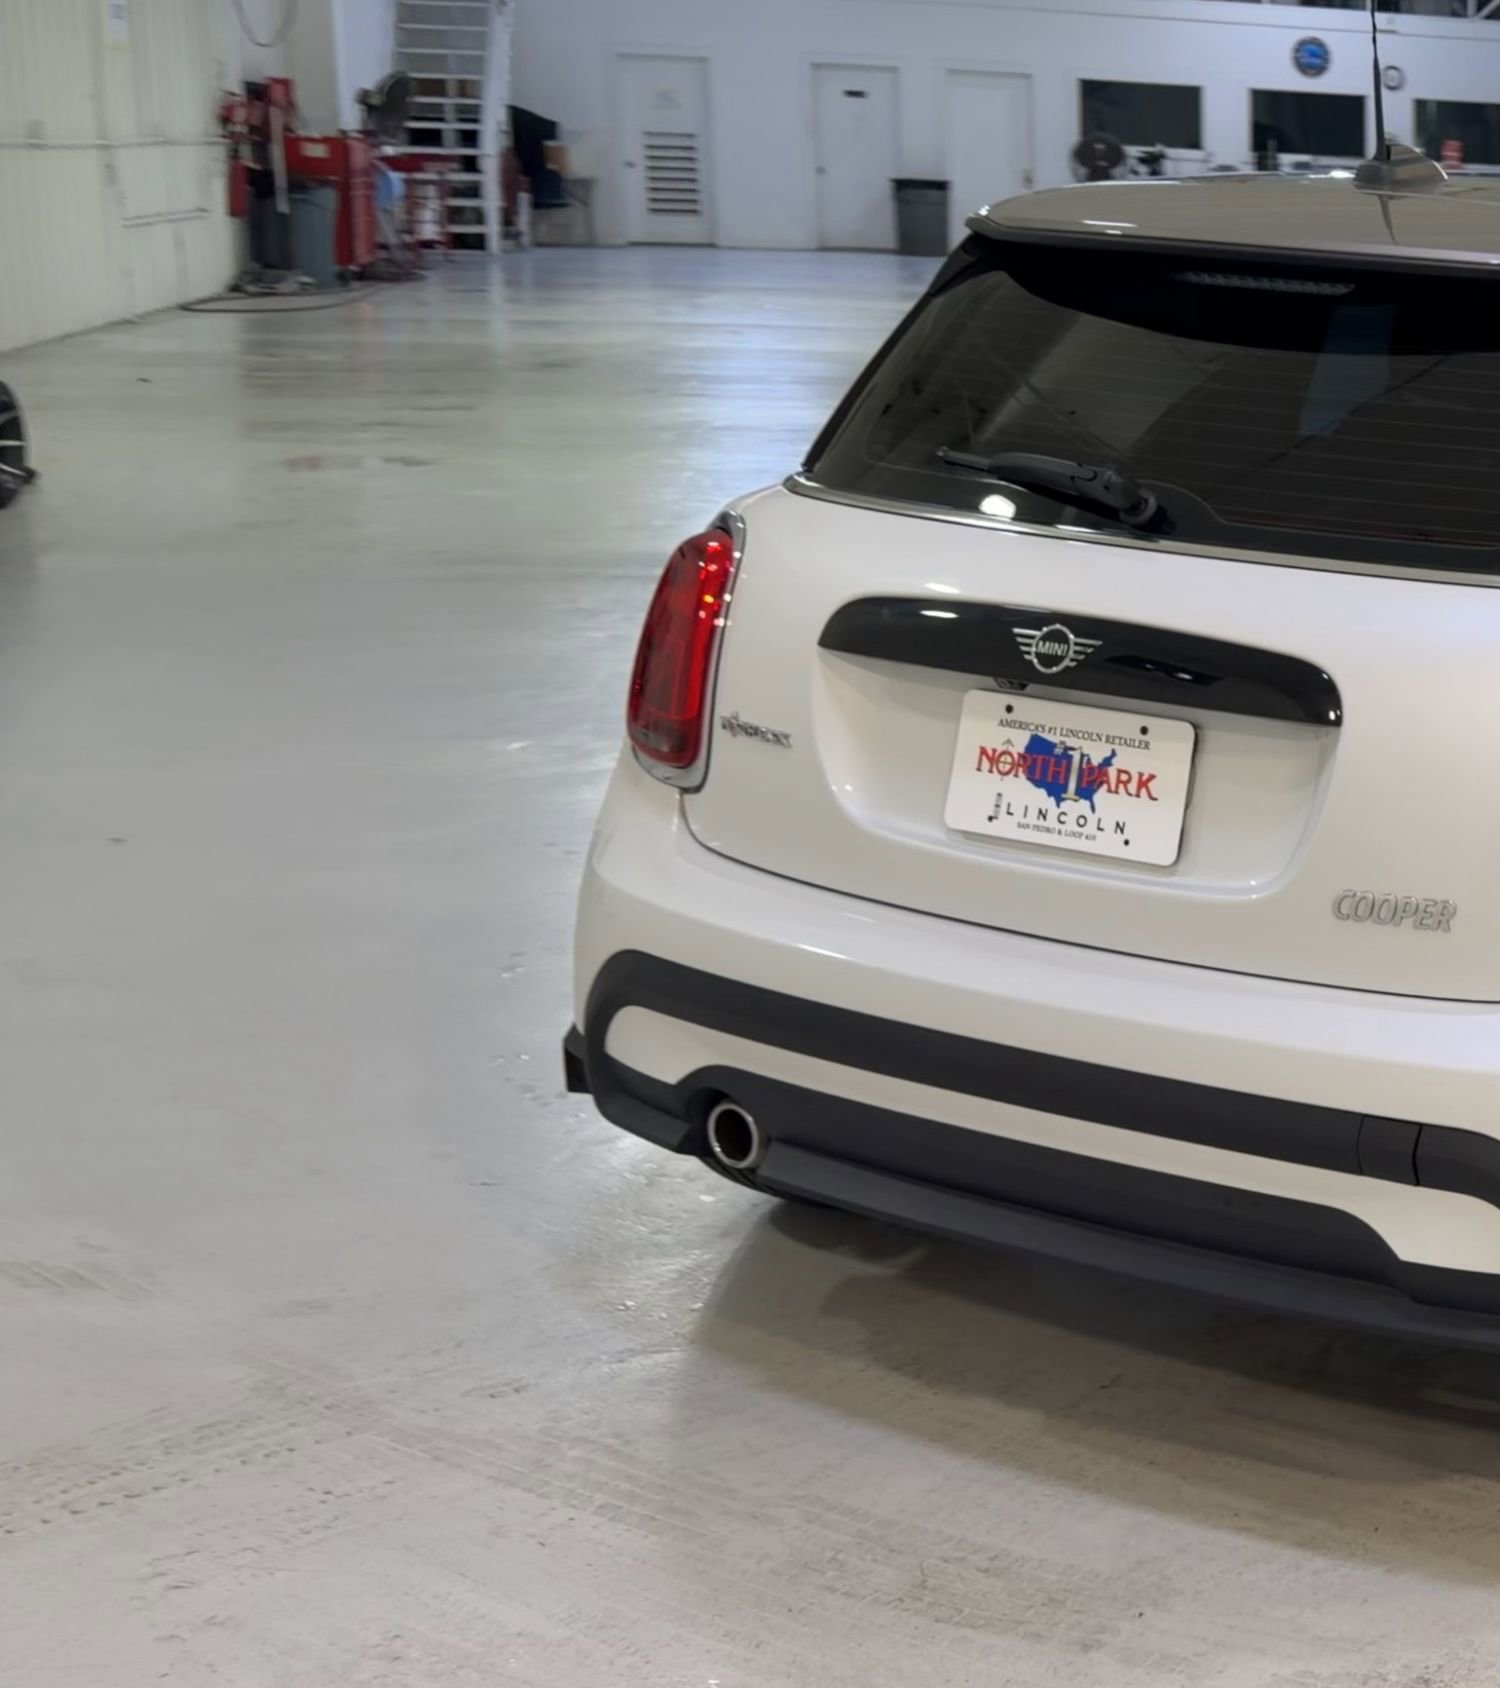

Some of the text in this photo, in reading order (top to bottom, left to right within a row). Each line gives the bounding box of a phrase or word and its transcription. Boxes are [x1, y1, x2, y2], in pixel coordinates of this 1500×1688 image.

[1036, 640, 1068, 656] MINI
[998, 718, 1046, 733] AMERICA'S
[1059, 727, 1104, 742] LINCOLN
[1104, 735, 1151, 750] RETAILER
[976, 745, 1158, 801] NORTH PARK
[1006, 802, 1126, 835] LINCOLN
[1332, 889, 1457, 933] COOPER
